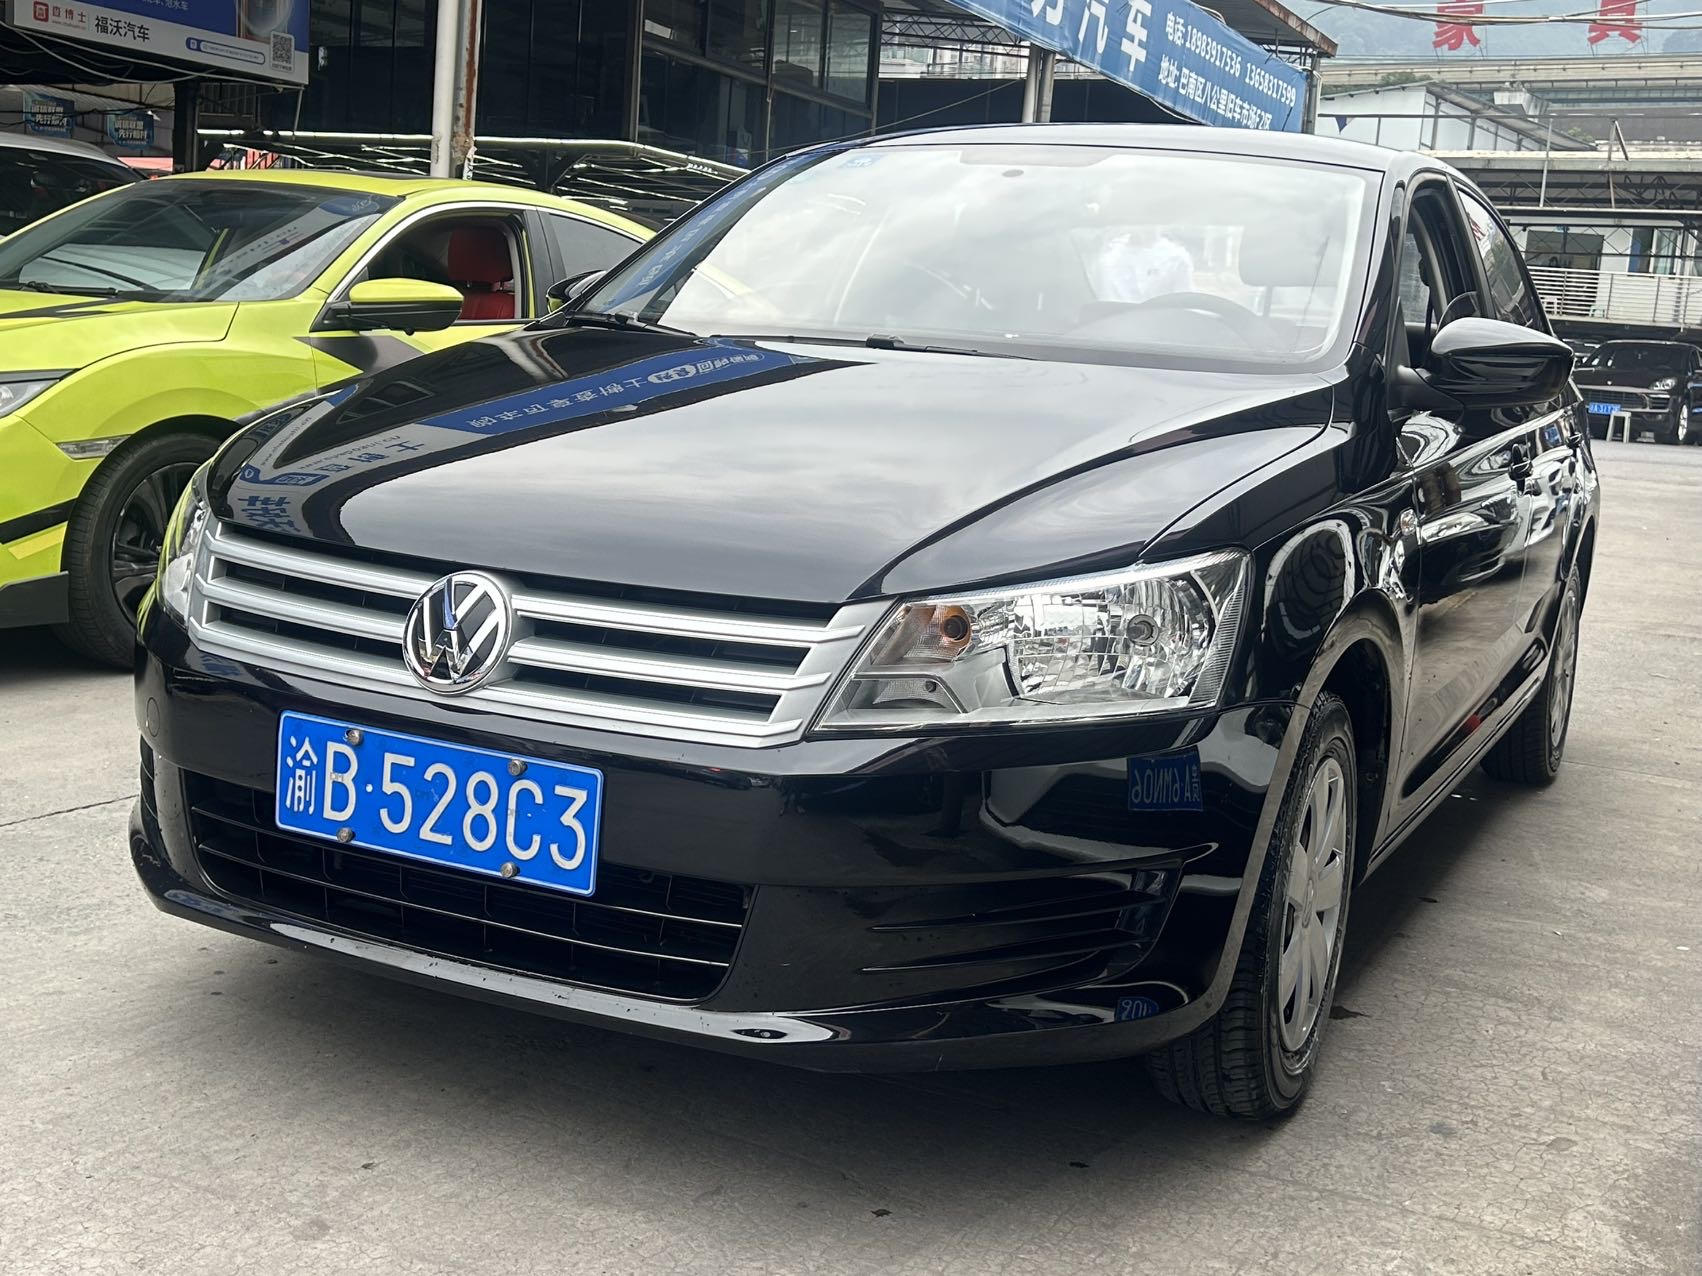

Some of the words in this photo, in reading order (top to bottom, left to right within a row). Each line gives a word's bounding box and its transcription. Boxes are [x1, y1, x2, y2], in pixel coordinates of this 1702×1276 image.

[94, 15, 150, 42] 福沃汽车
[285, 735, 589, 871] 渝B·528C3
